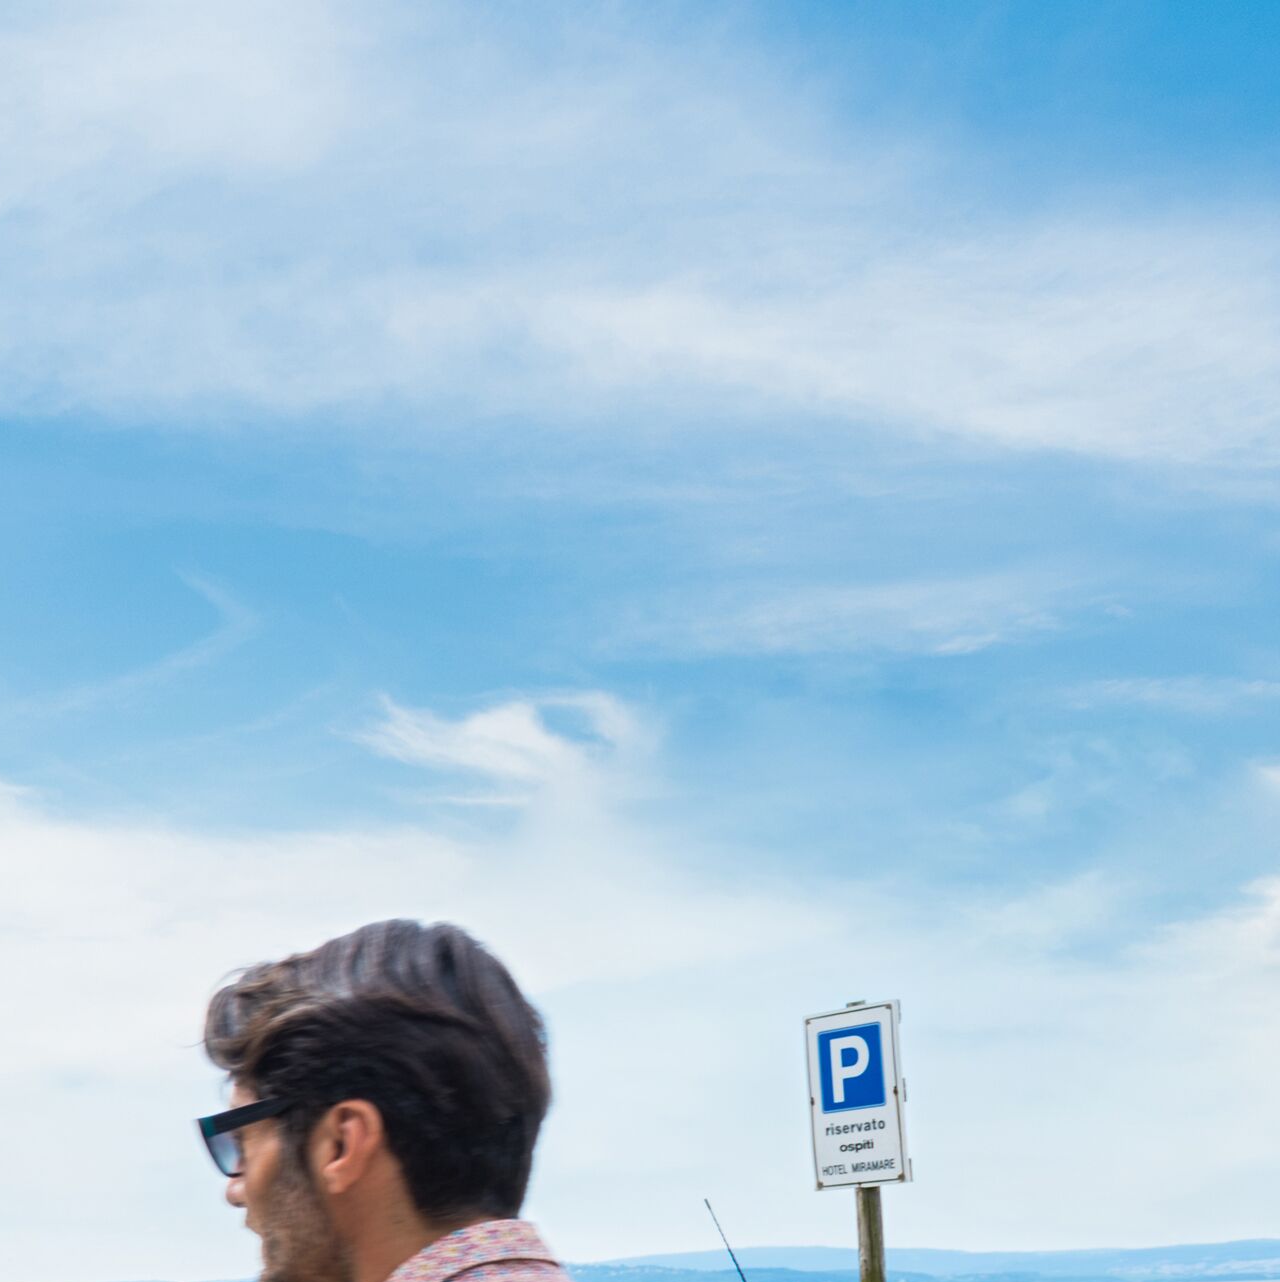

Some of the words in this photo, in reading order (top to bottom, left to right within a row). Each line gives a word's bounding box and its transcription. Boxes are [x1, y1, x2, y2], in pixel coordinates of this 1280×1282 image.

[829, 1035, 870, 1104] P
[825, 1118, 886, 1136] riservato
[839, 1138, 875, 1154] ospiti
[822, 1164, 848, 1177] HOTEL
[851, 1158, 896, 1174] MIRAMARE
